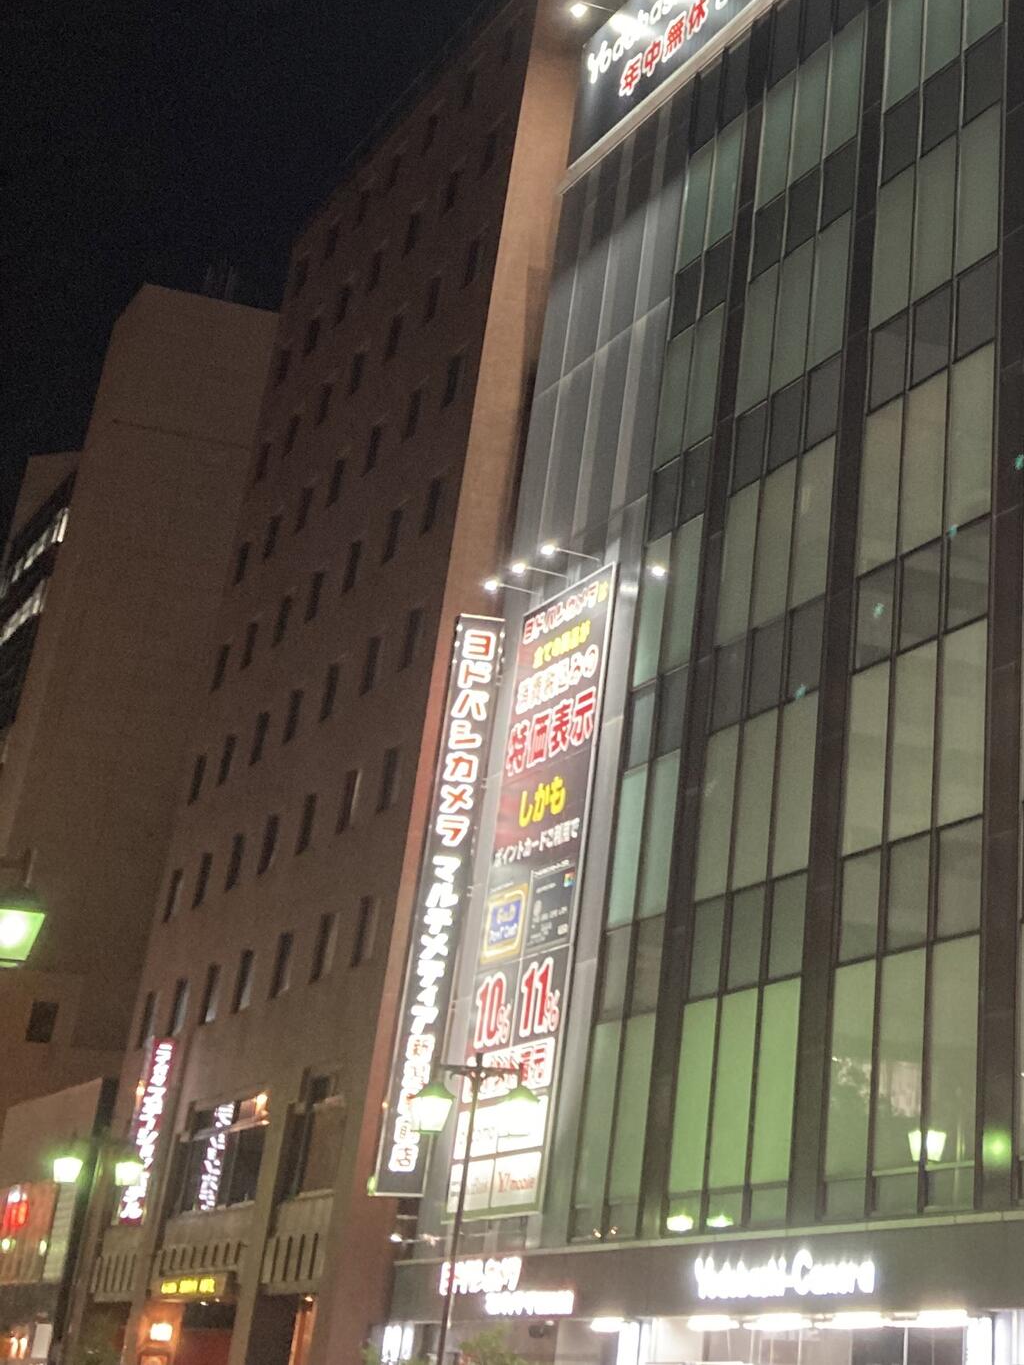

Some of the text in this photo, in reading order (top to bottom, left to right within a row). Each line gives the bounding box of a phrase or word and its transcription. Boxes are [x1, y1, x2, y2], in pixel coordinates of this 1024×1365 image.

[434, 628, 497, 849] ヨドバシカメラ
[518, 775, 567, 829] しかも
[473, 970, 512, 1049] 10%
[518, 956, 560, 1037] 11%
